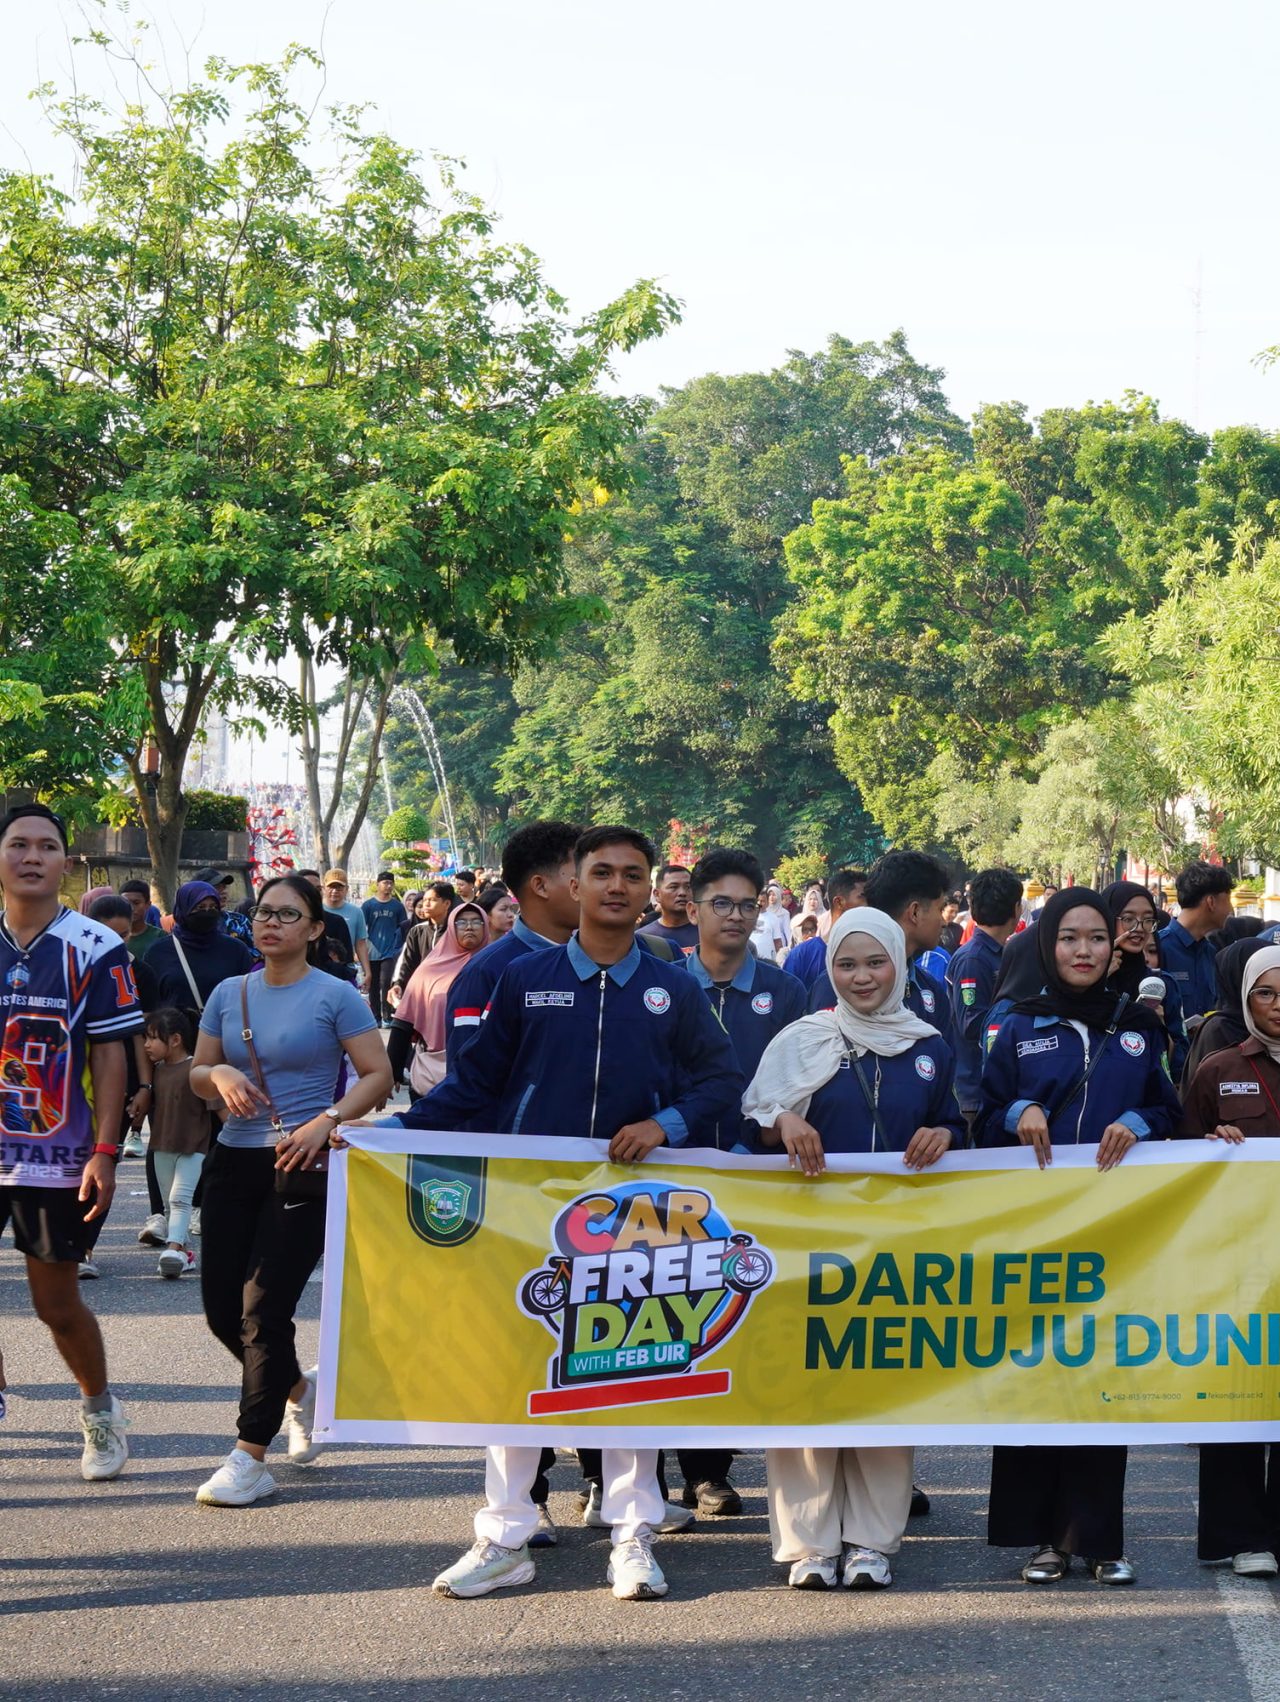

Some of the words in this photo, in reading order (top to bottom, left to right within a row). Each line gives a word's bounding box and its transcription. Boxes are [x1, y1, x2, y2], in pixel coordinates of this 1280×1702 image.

[18, 1163, 64, 1179] 2025
[563, 1190, 711, 1255] CAR
[571, 1241, 725, 1304] FREE
[807, 1251, 974, 1307] DARI
[991, 1251, 1107, 1305] FEB
[573, 1290, 725, 1354] DAY
[804, 1314, 1097, 1371] MENUJU
[573, 1356, 611, 1373] WITH
[614, 1349, 650, 1368] FEB
[653, 1344, 686, 1363] UIR
